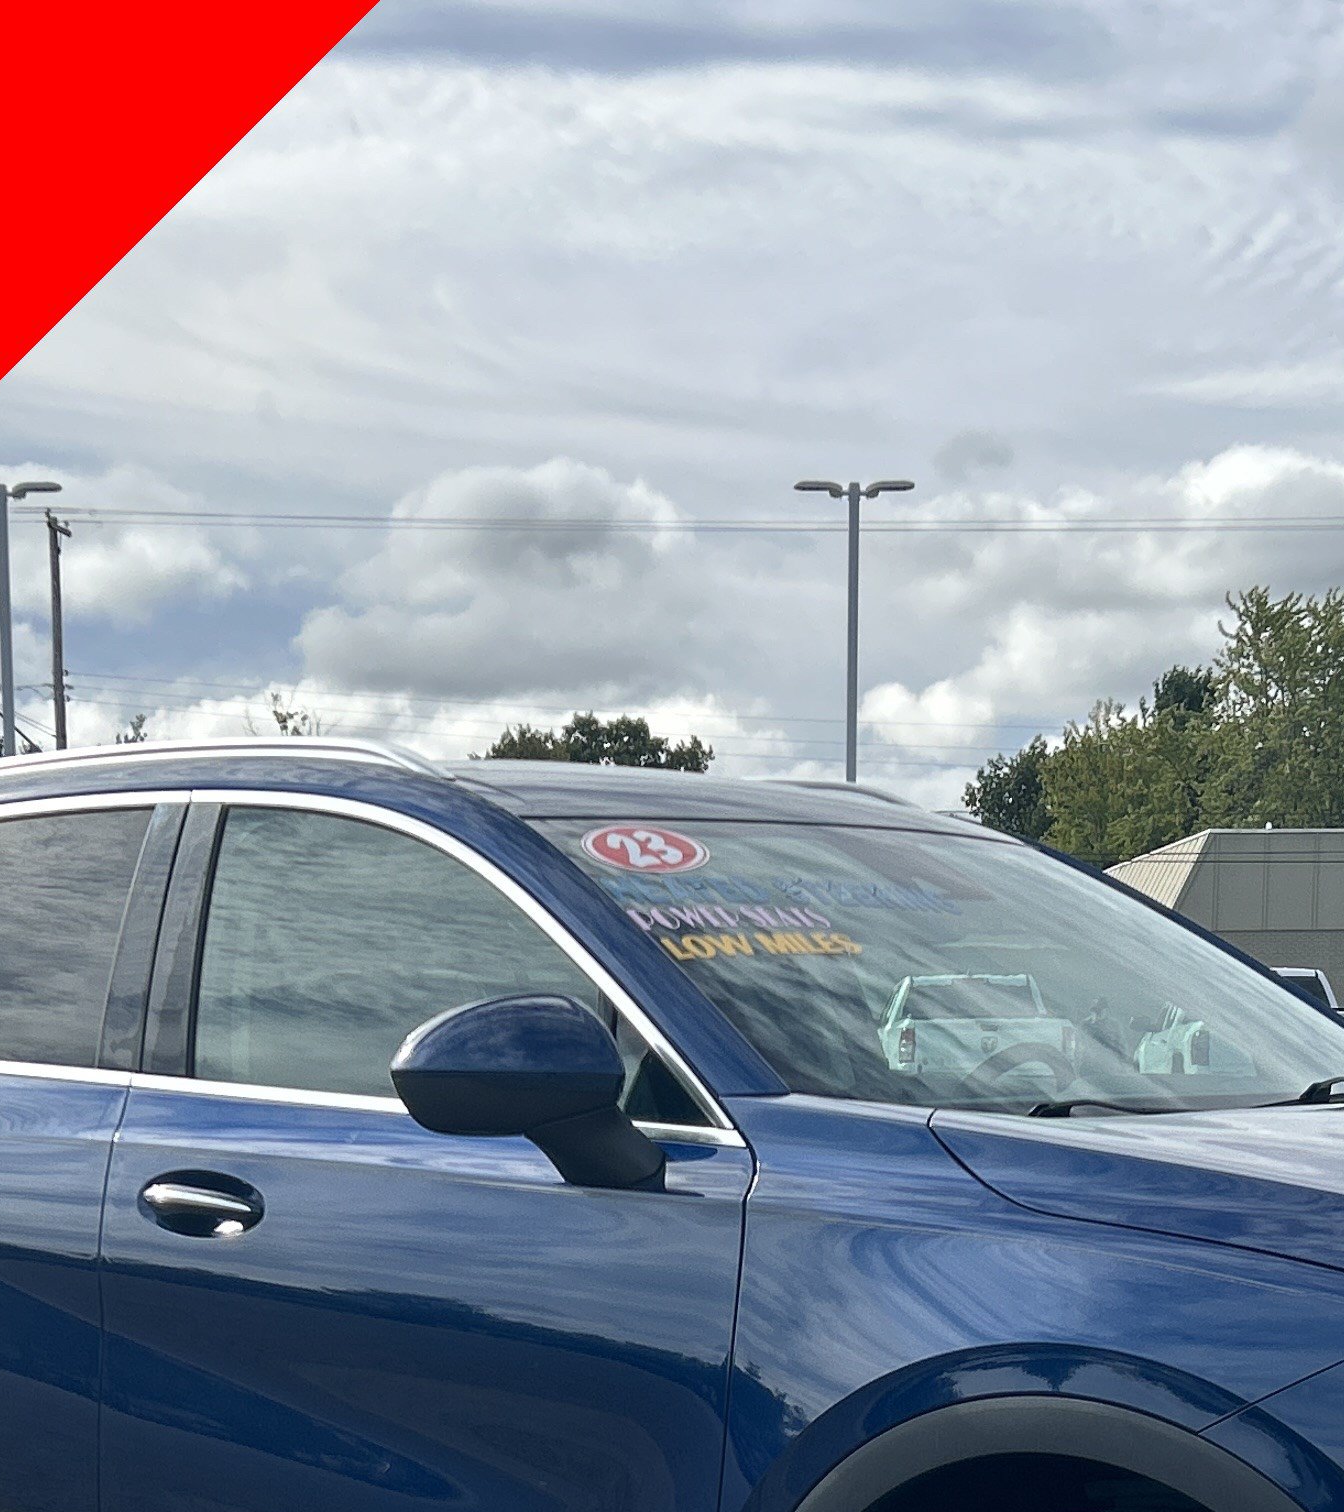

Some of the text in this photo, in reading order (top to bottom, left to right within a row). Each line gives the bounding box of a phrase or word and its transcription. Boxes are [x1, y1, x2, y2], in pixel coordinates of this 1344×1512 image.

[606, 830, 684, 868] 23
[660, 932, 863, 961] LOW MILES
